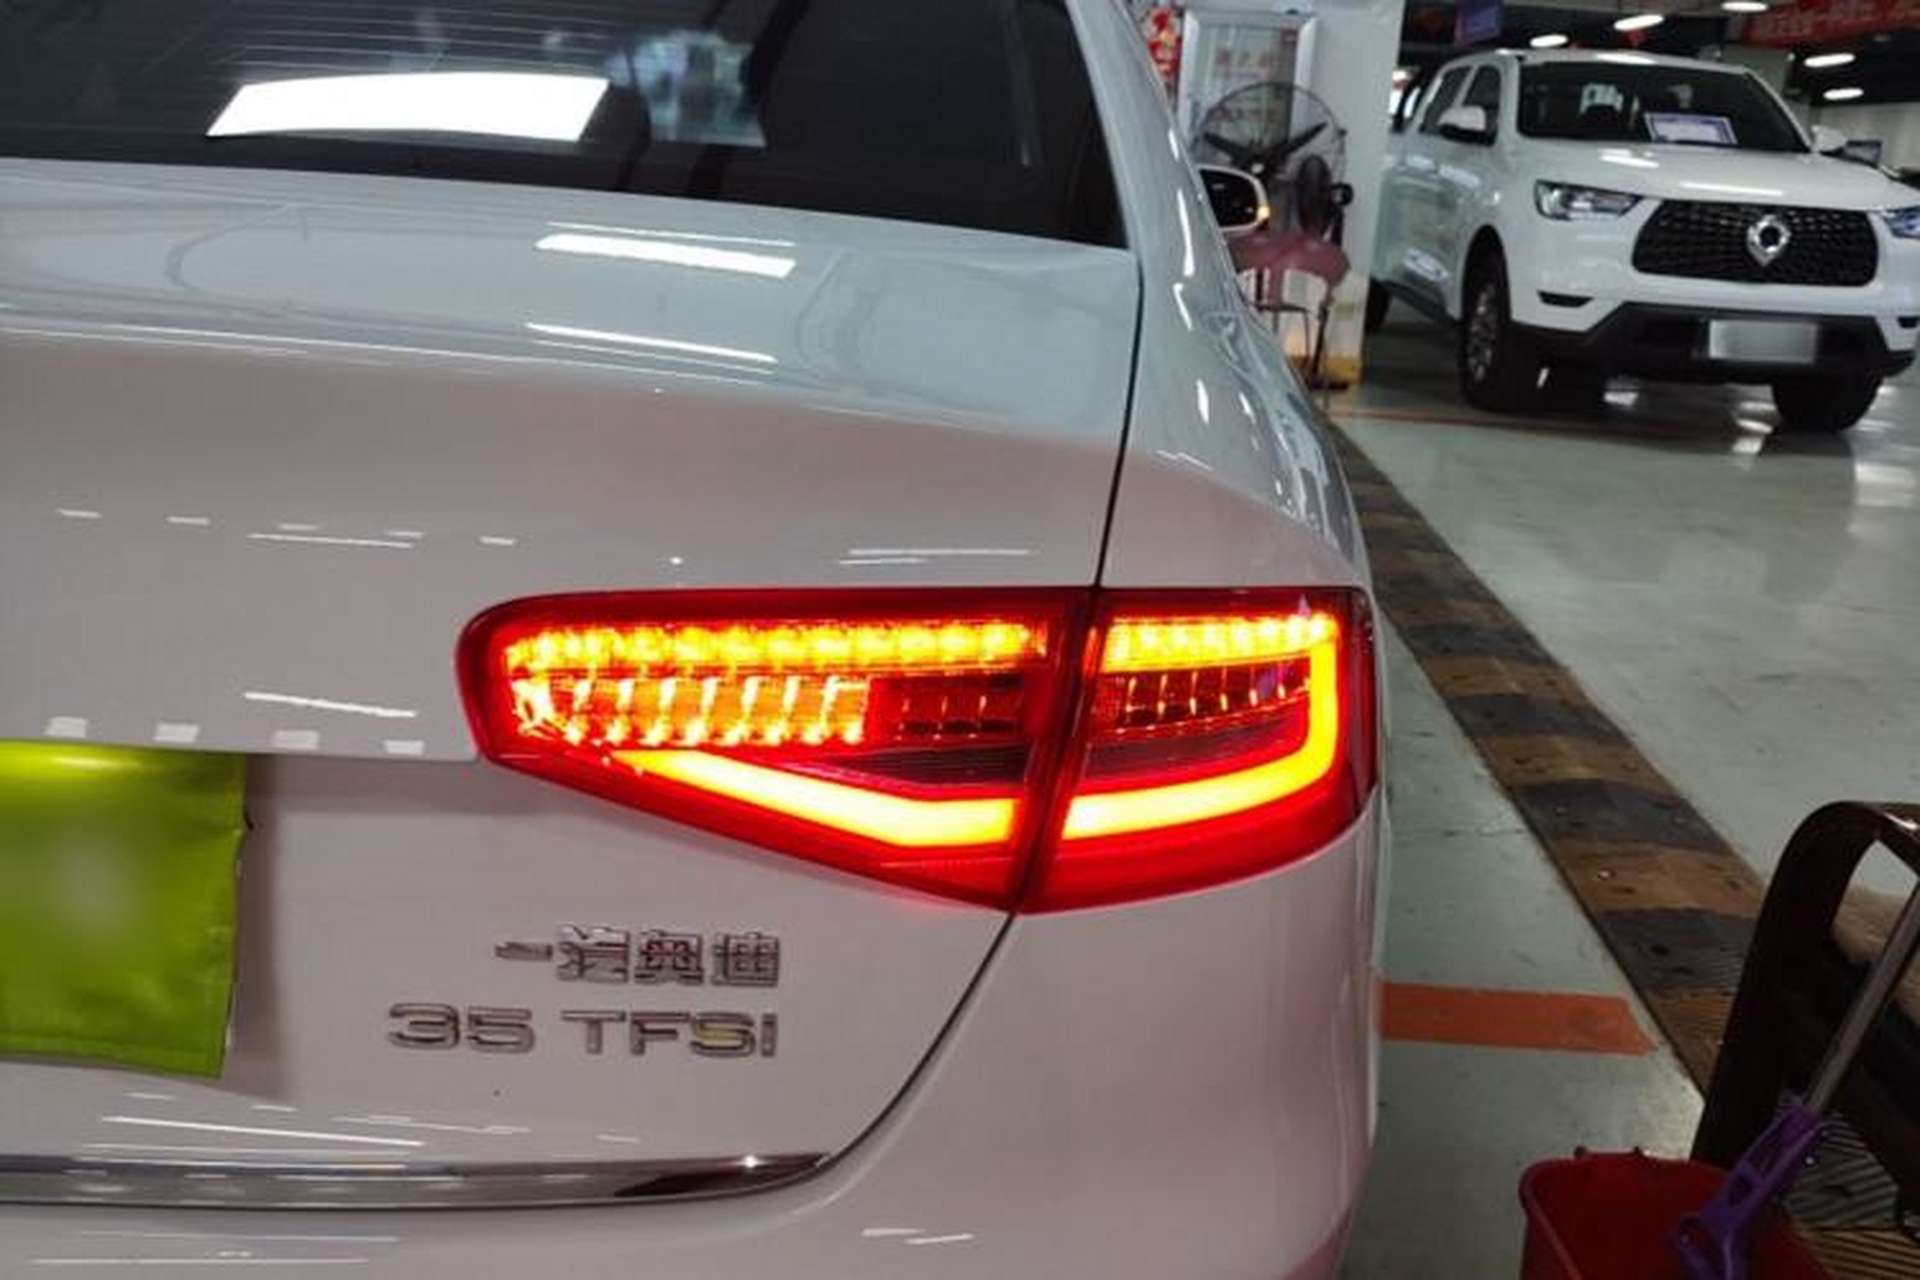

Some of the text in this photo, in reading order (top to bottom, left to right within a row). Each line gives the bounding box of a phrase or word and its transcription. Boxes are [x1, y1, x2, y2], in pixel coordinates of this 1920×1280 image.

[495, 925, 780, 987] 一汽奥迪
[388, 1003, 778, 1057] 35 TFSI
